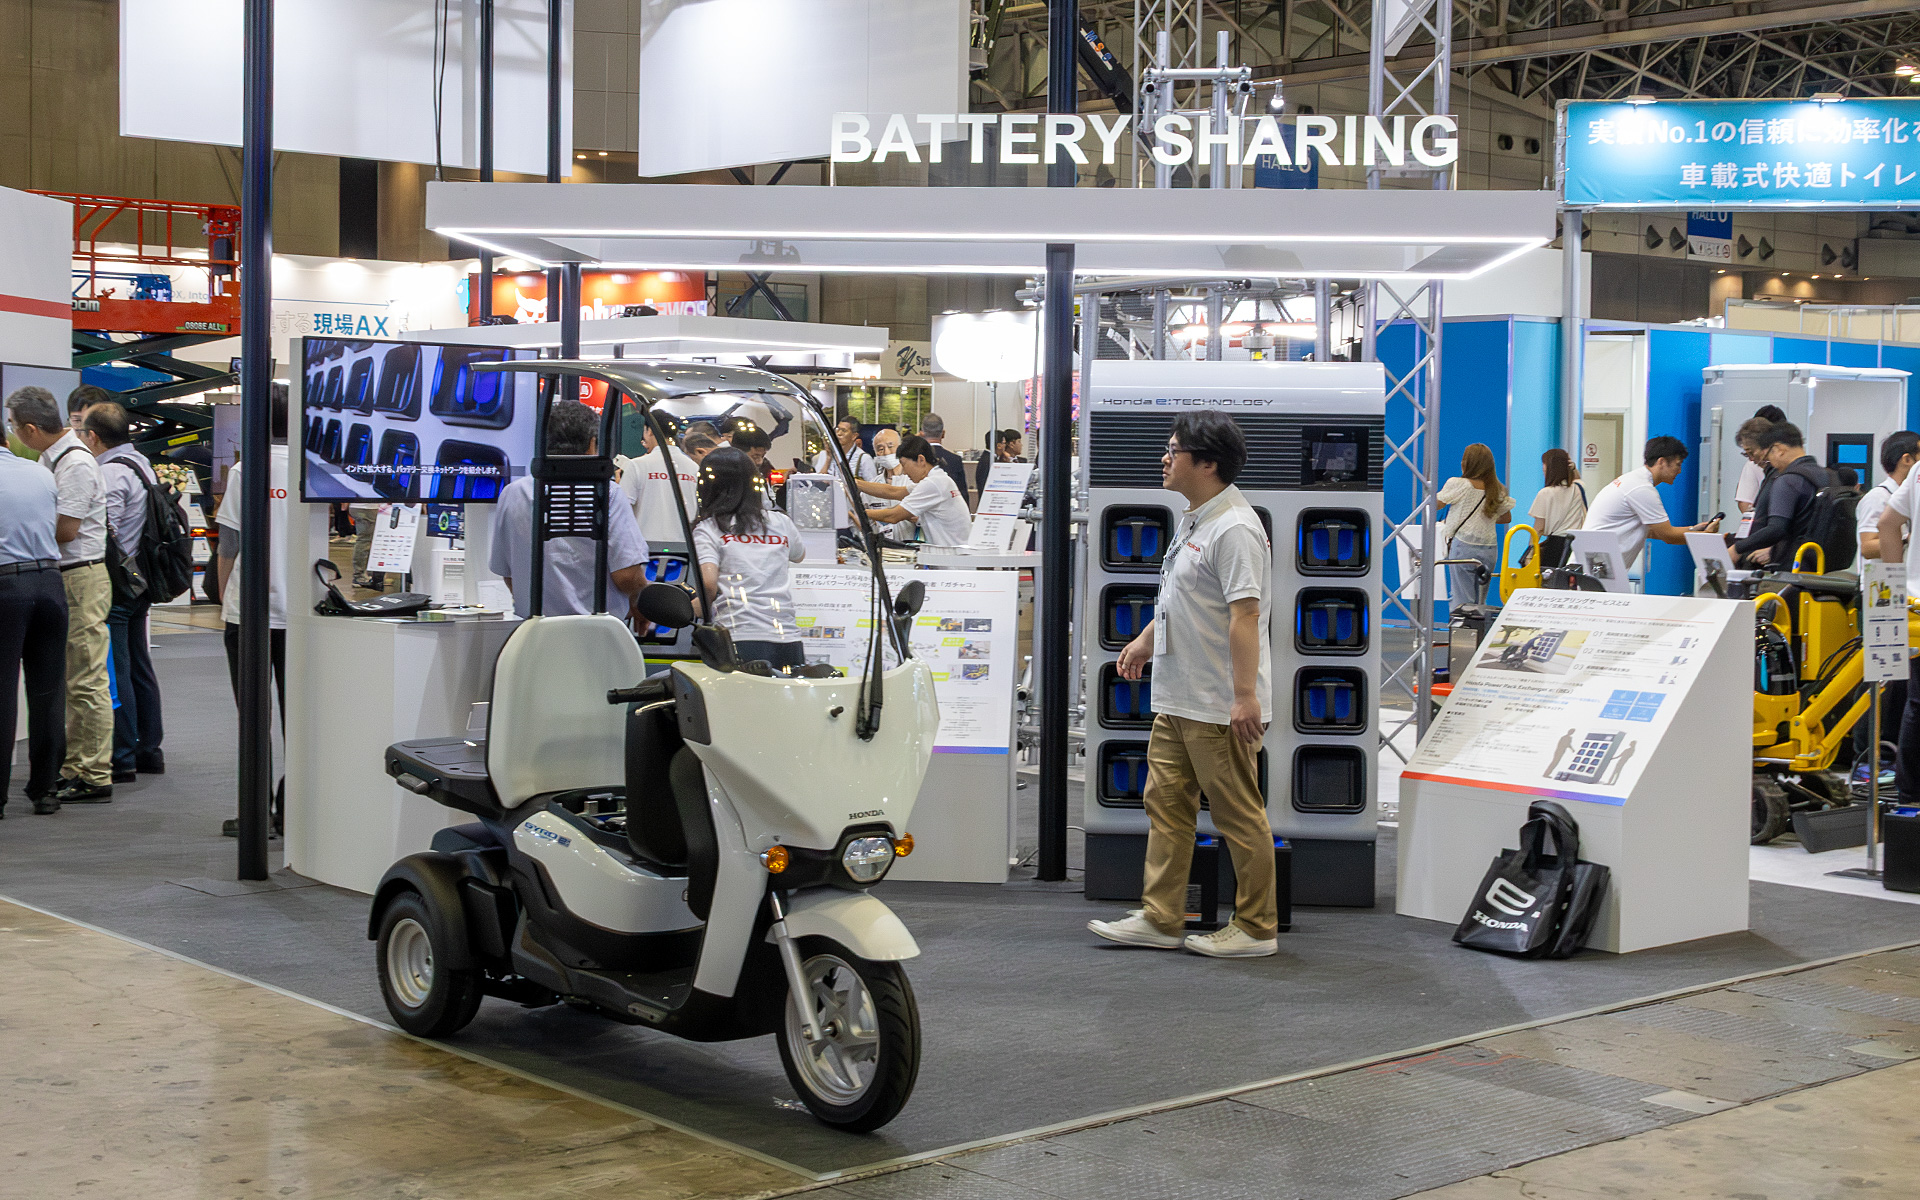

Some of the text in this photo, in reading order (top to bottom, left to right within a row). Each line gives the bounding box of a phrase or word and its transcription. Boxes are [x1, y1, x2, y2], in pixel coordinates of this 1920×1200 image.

[831, 114, 1458, 166] BATTERY SHARING
[1680, 162, 1917, 189] 車載式快適トイレ
[720, 534, 789, 548] HONDA
[848, 809, 885, 820] HONDA
[1472, 909, 1529, 932] HONDA
